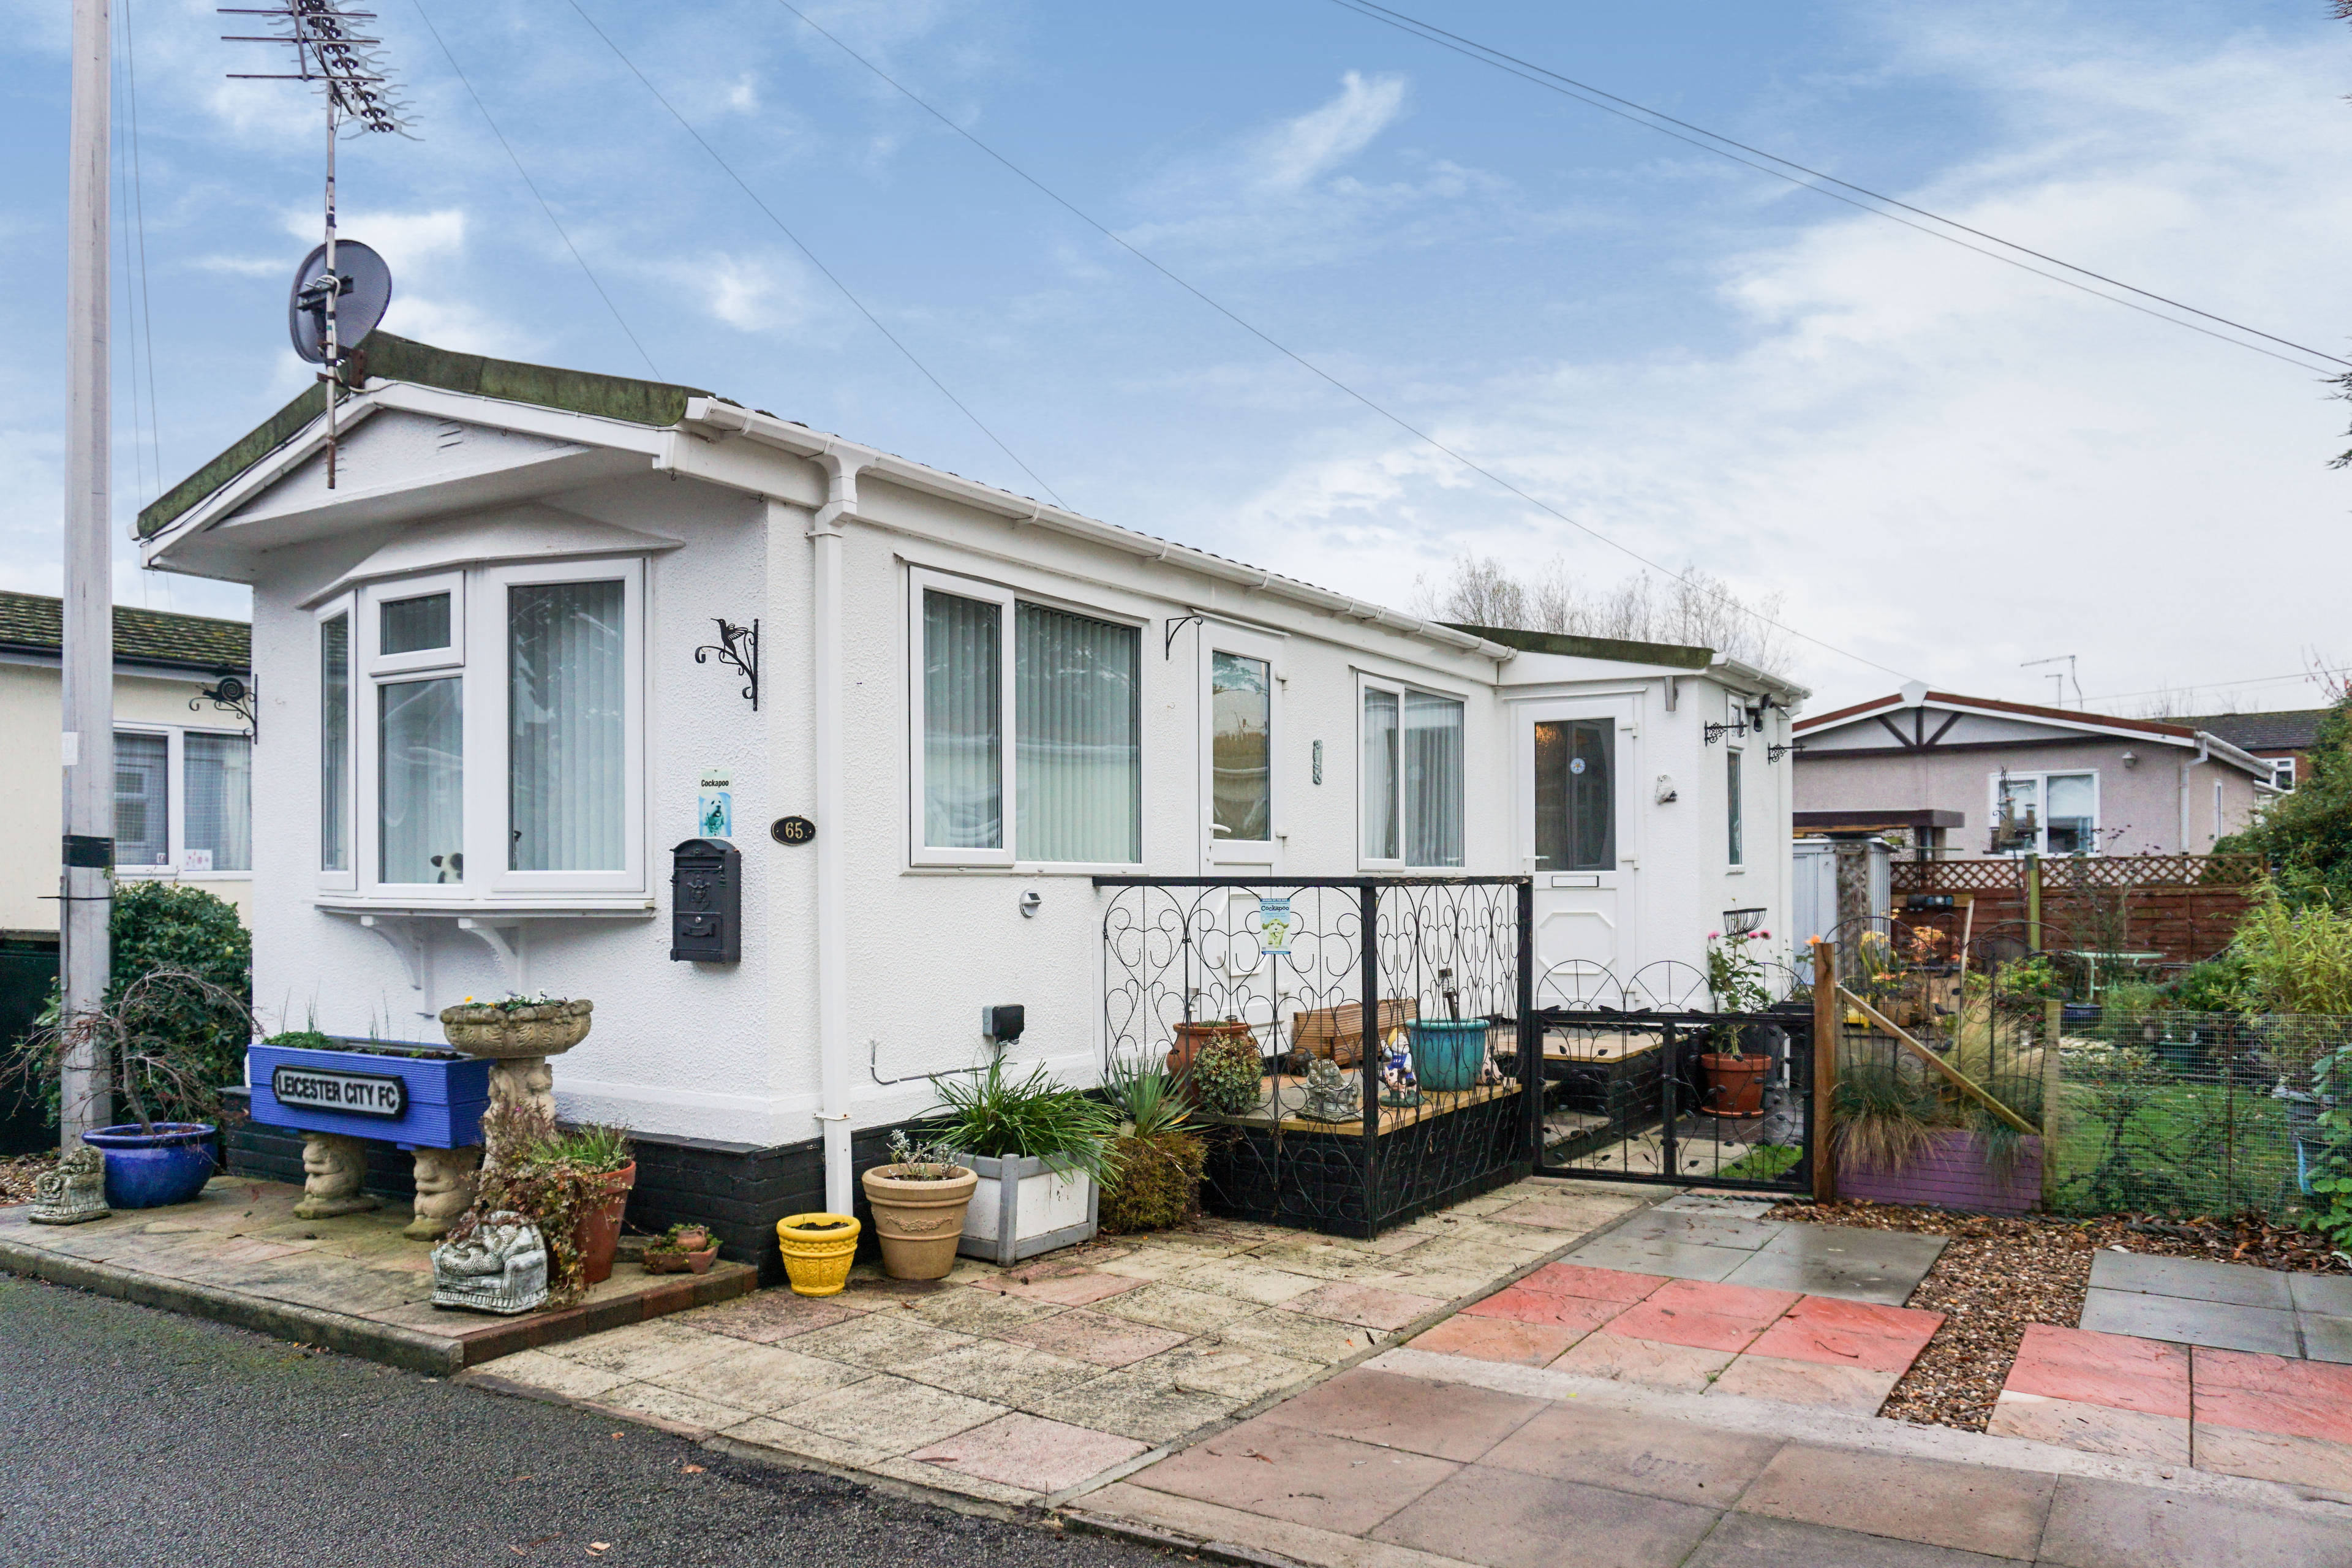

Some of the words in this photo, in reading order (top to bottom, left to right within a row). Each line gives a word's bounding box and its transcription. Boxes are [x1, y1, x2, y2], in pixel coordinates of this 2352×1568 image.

[701, 779, 729, 788] Cockapoo
[785, 822, 803, 839] 65
[277, 1074, 341, 1102] LEICESTER
[344, 1082, 374, 1106] CITY
[377, 1085, 396, 1108] FC
